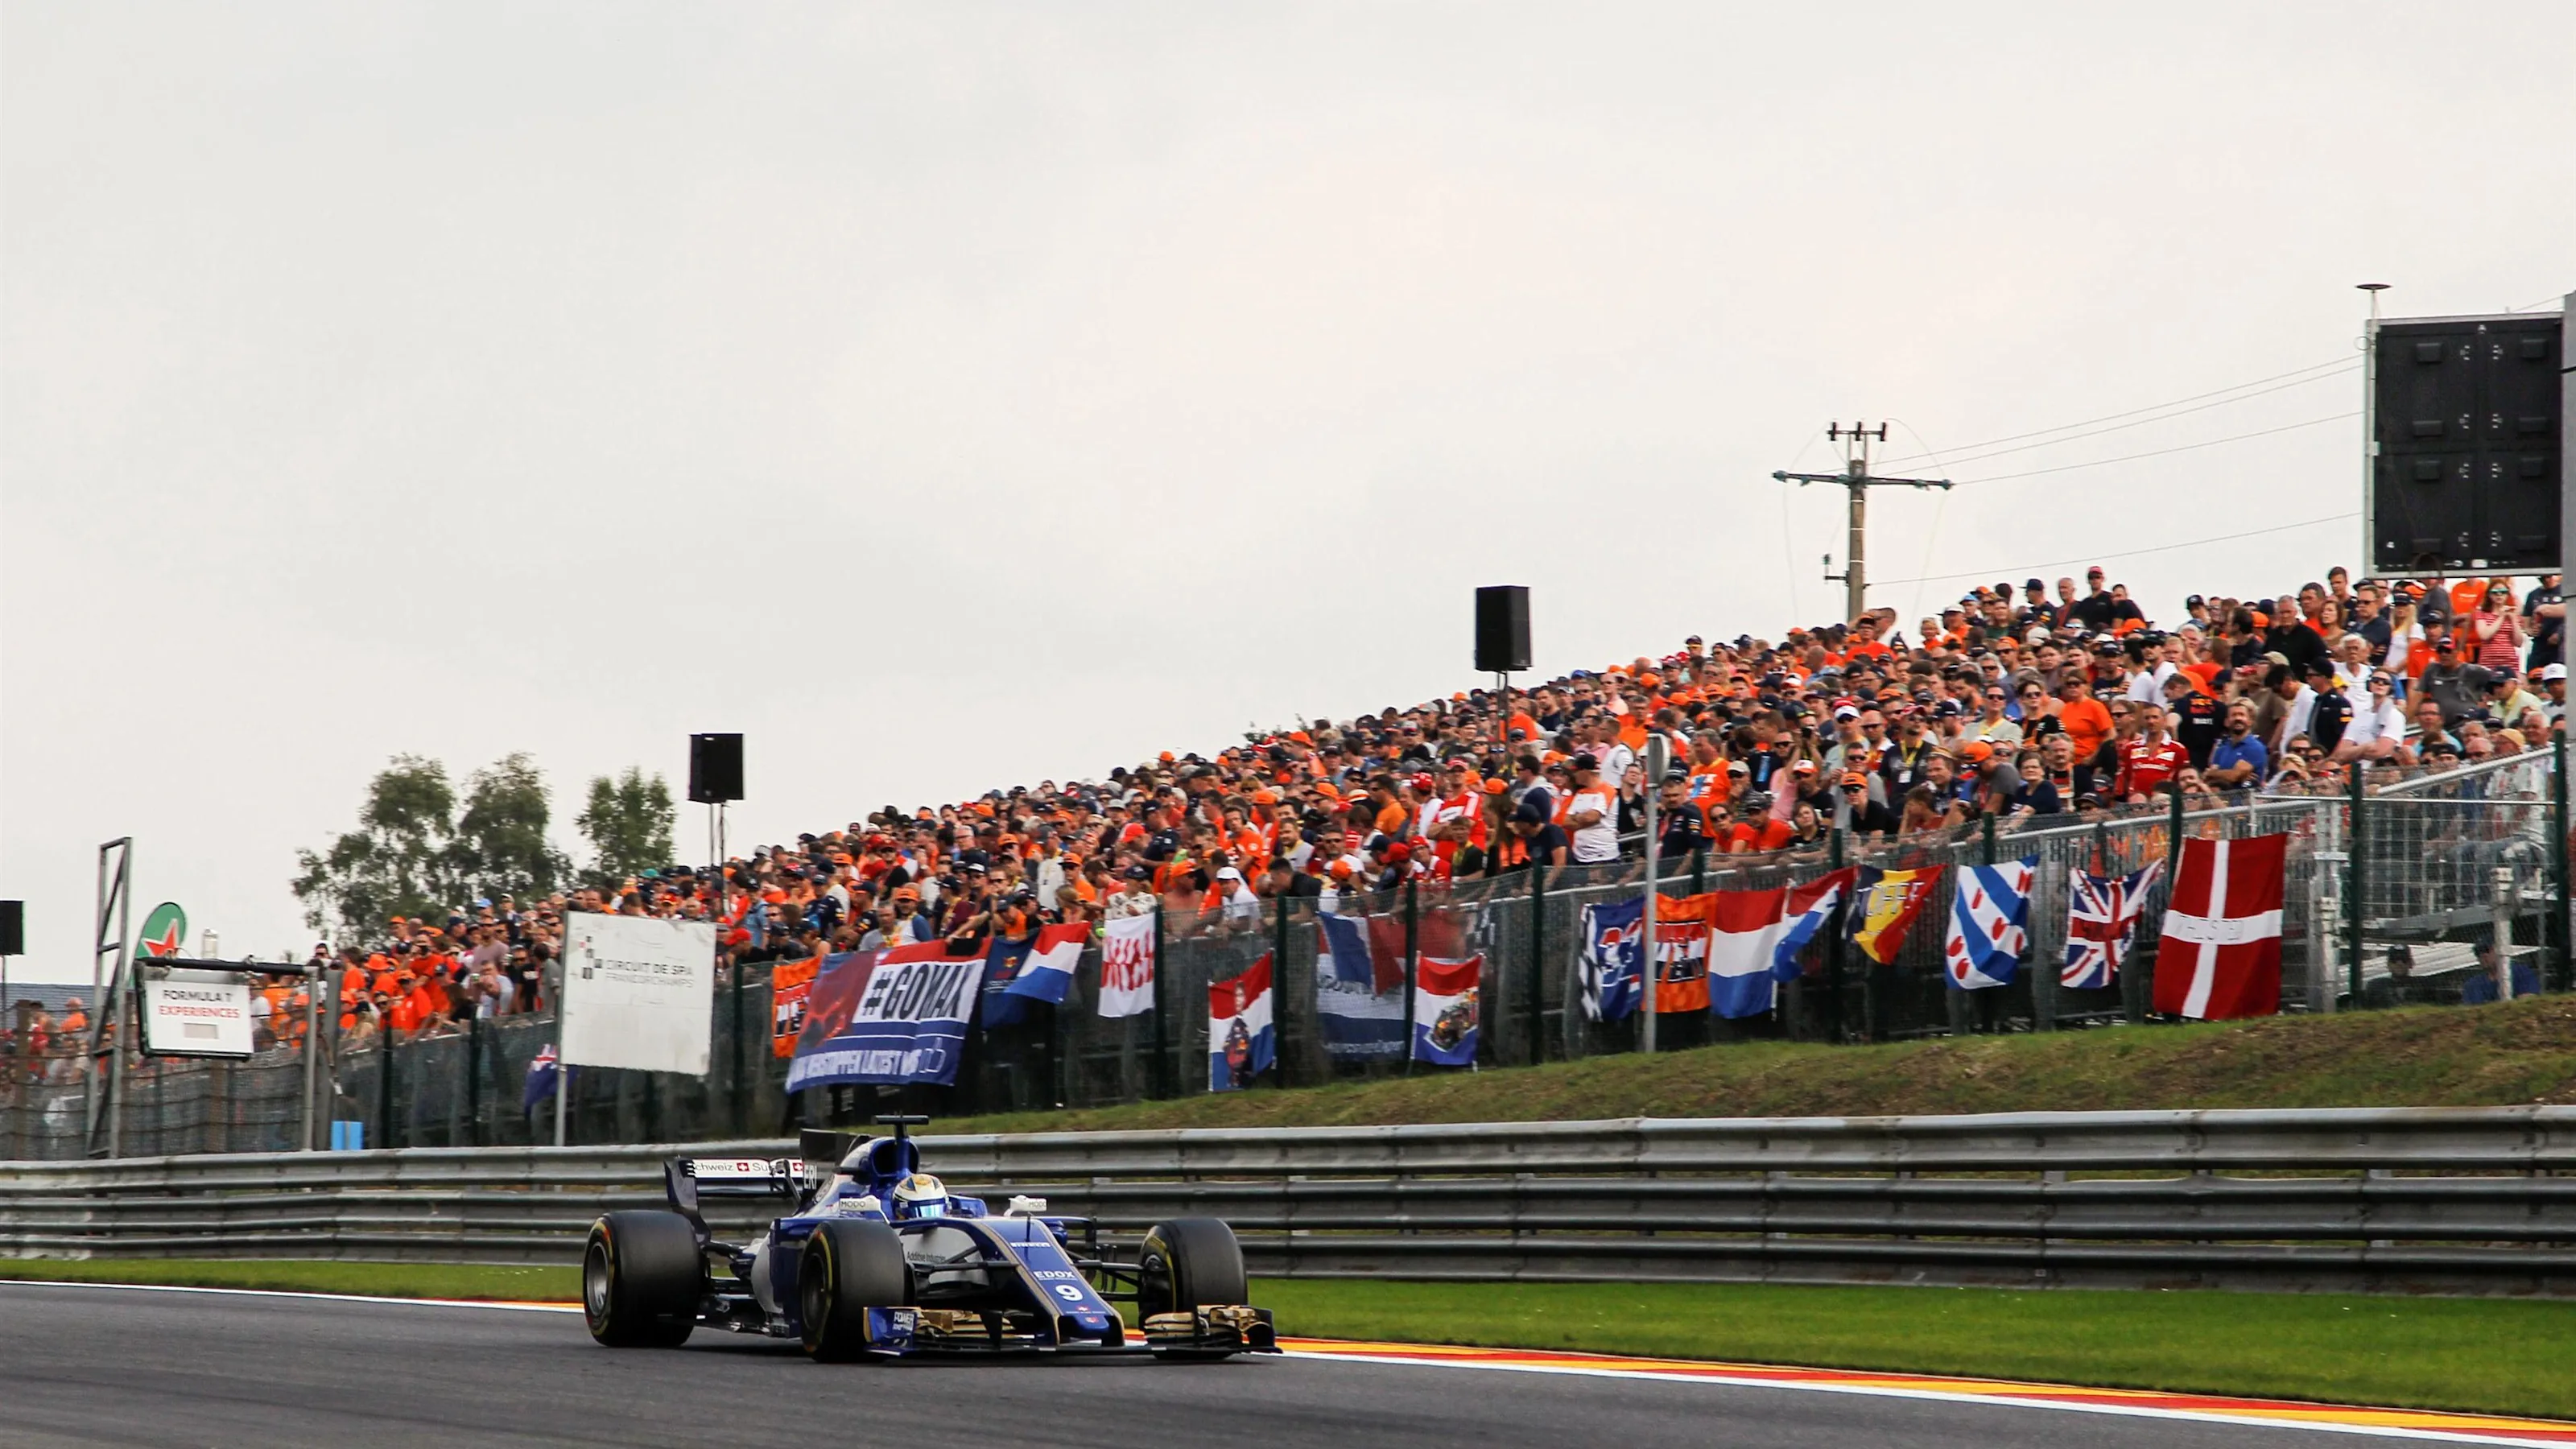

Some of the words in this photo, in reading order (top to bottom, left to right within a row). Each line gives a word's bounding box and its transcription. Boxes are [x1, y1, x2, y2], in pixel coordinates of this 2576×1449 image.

[606, 960, 650, 972] CIRCUIT
[653, 964, 667, 974] DE
[670, 965, 693, 976] SPA
[163, 989, 222, 1002] FORMULA
[159, 1005, 241, 1019] EXPERIENCES
[694, 1162, 735, 1172] chweiz
[1055, 1284, 1084, 1302] 9
